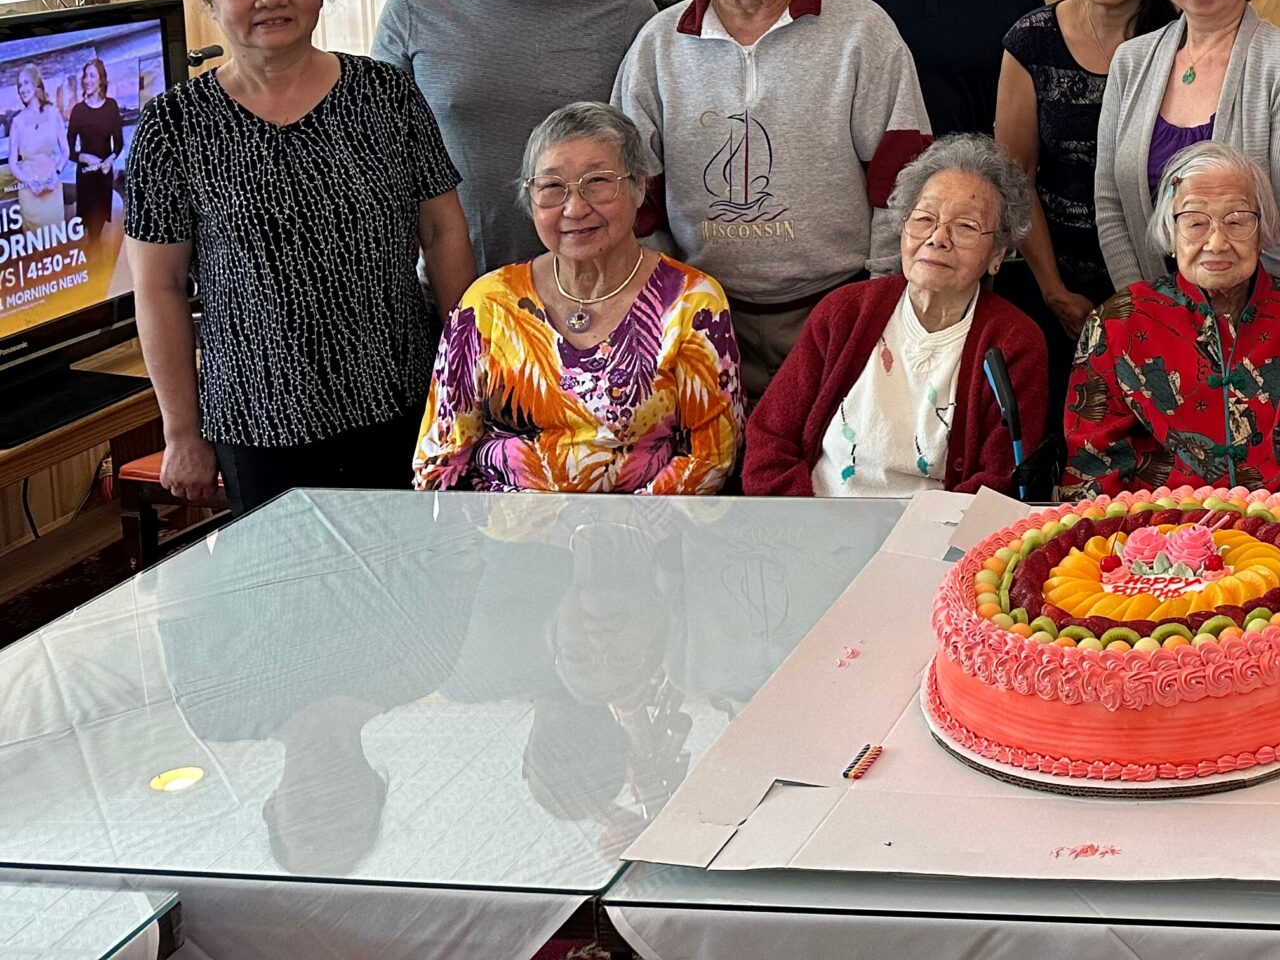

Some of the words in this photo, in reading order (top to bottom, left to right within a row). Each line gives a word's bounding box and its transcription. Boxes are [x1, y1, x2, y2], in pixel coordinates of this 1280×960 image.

[702, 220, 795, 241] WISCONSIN
[27, 248, 87, 279] 4:30-7A
[6, 281, 58, 308] MORNING
[59, 270, 89, 291] NEWS
[1124, 575, 1203, 591] Happy
